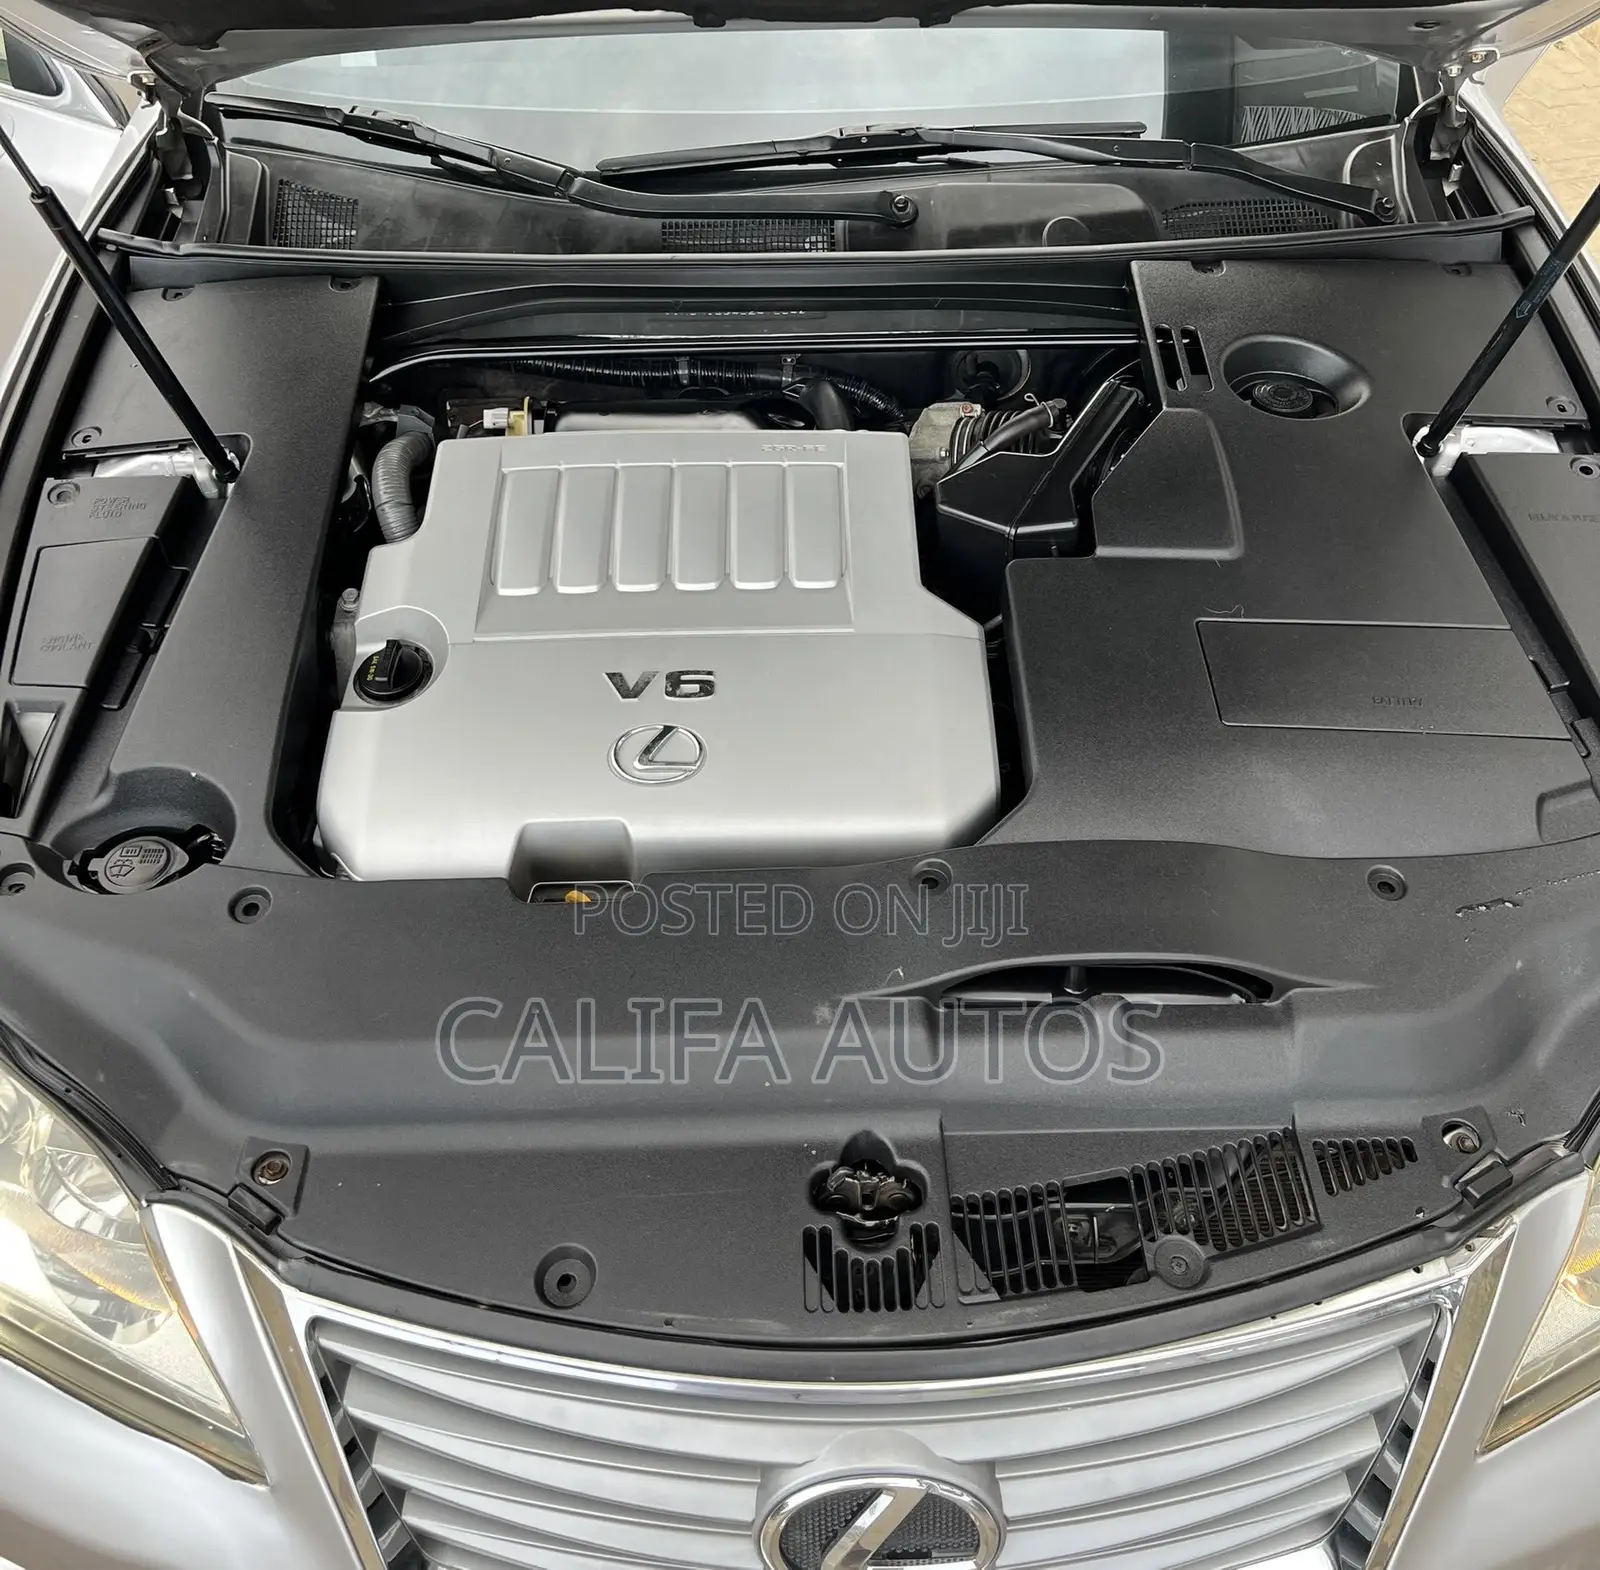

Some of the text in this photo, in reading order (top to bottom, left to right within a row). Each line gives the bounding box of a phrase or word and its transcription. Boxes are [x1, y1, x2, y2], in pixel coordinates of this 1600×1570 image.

[92, 501, 147, 512] STEERING
[88, 509, 123, 519] FLUID
[602, 669, 716, 702] V6
